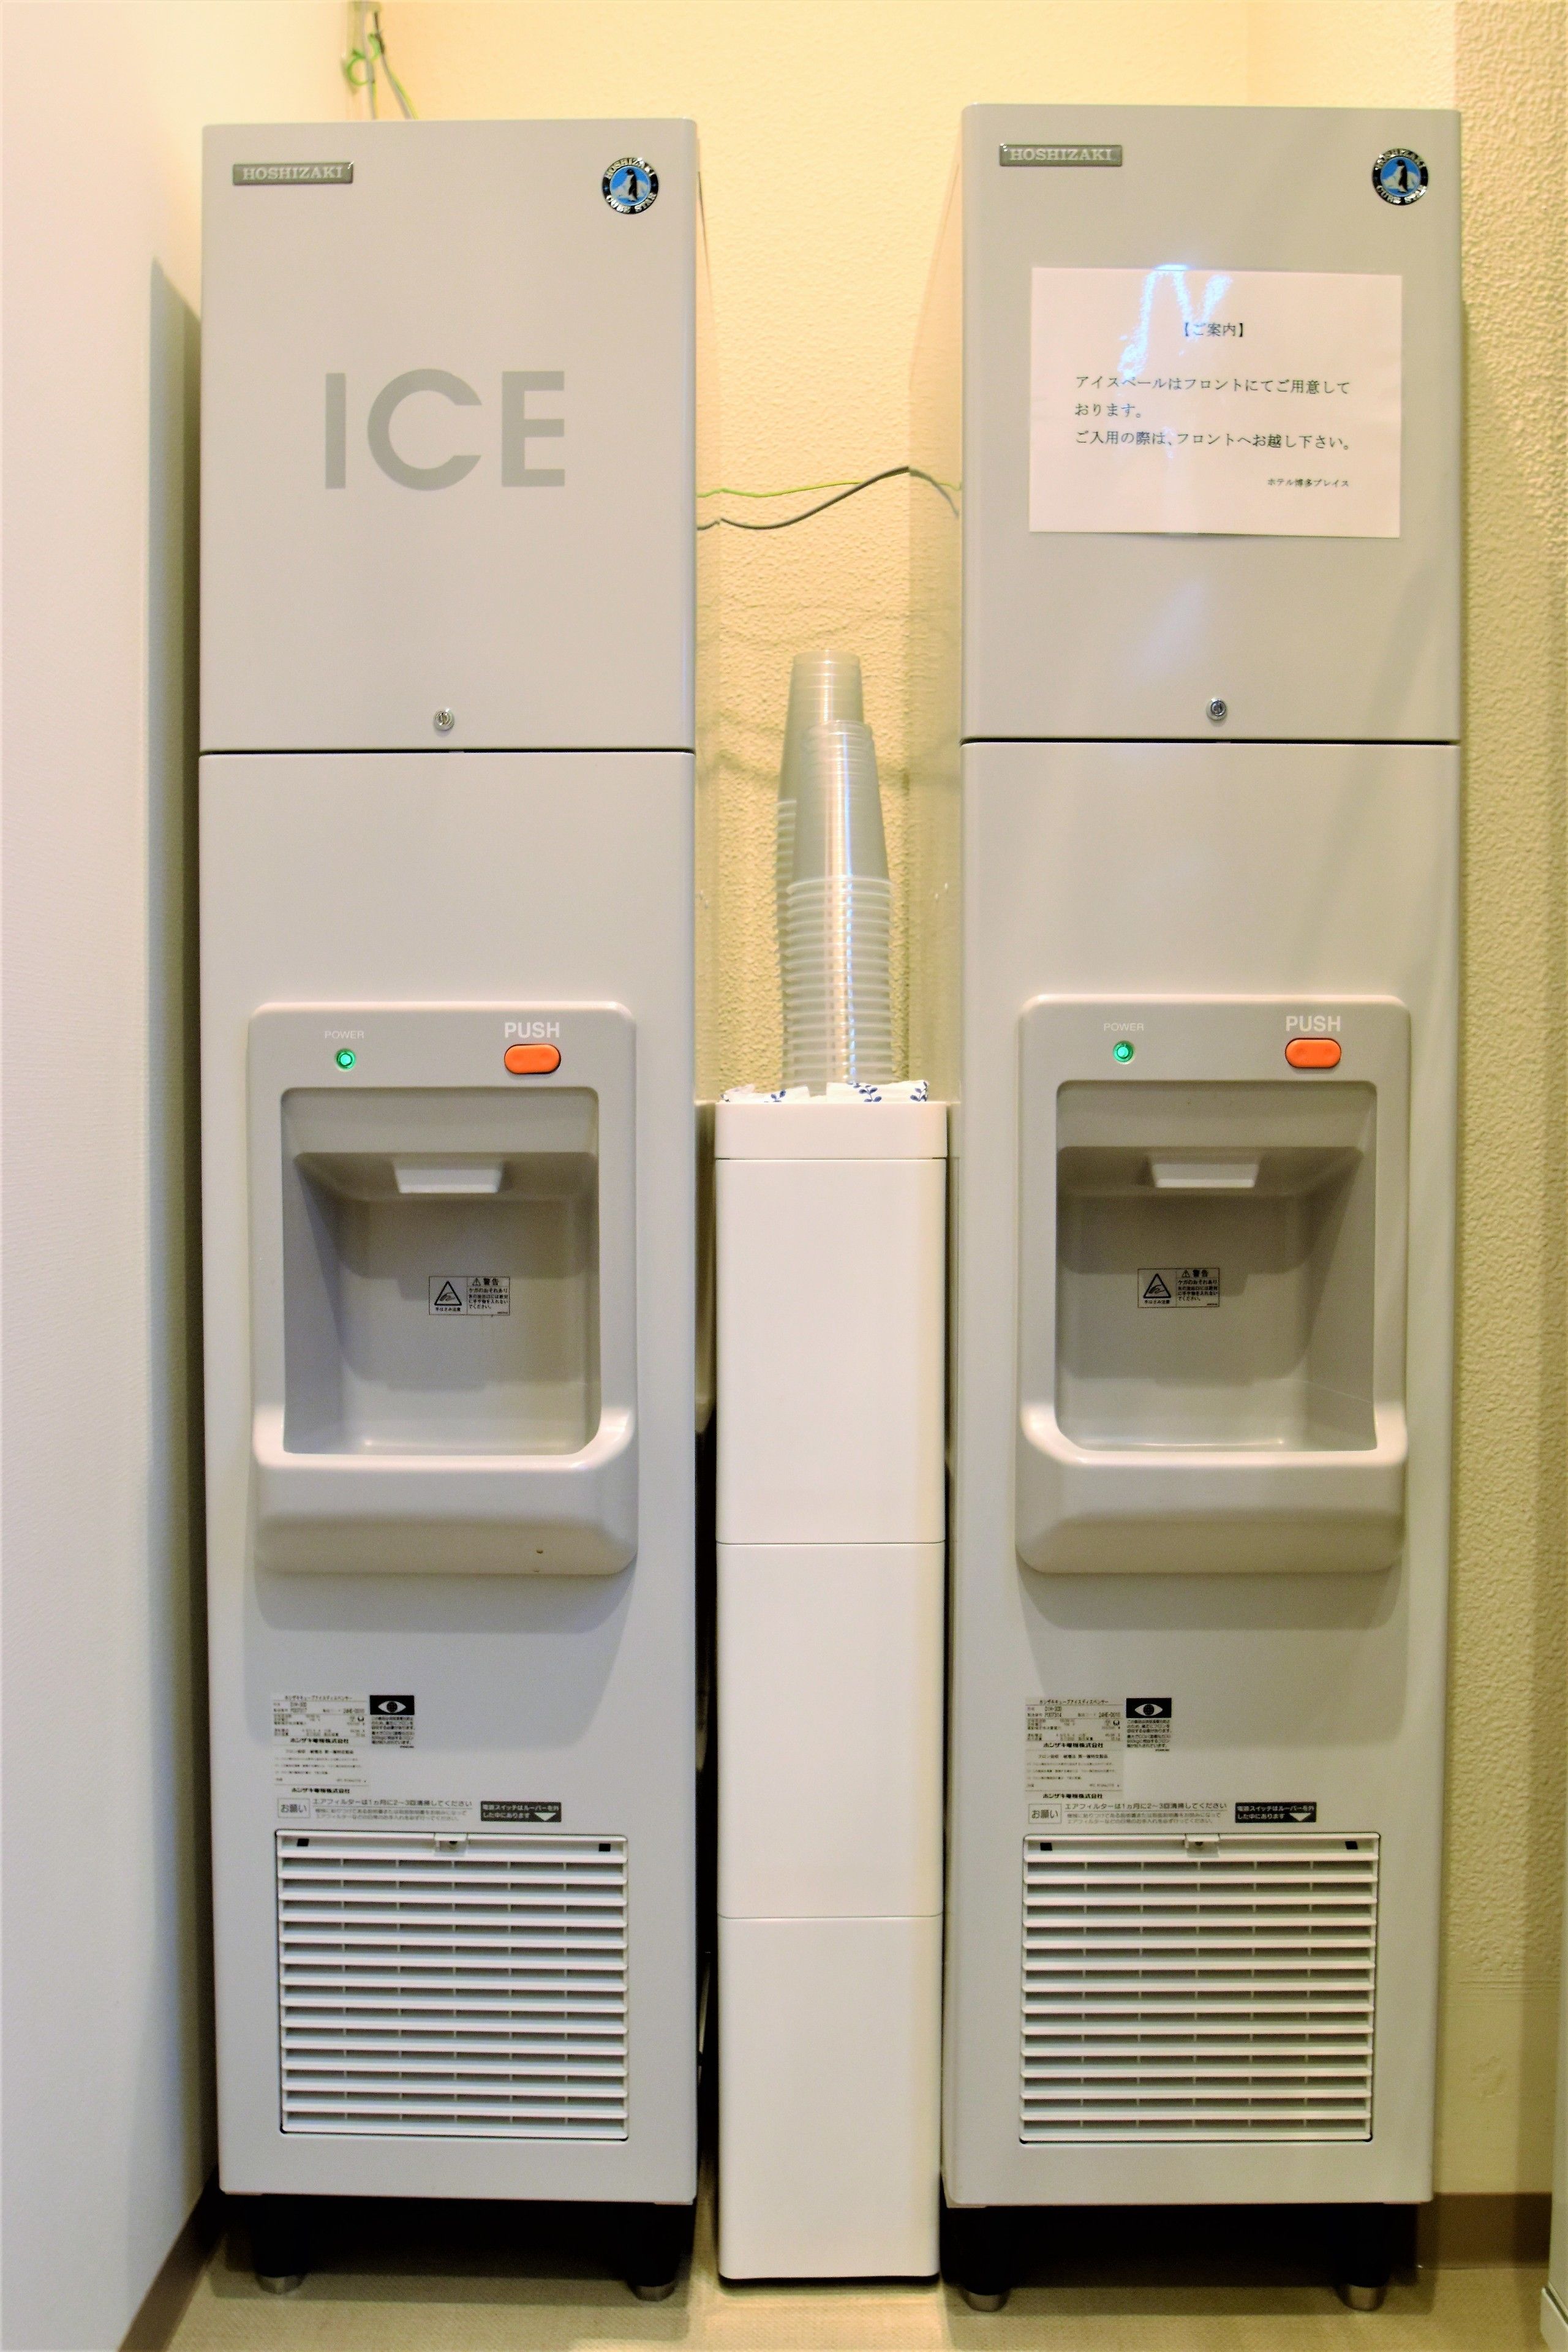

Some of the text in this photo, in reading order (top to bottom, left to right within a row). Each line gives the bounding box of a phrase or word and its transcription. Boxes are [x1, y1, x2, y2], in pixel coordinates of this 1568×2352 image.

[1010, 148, 1113, 161] HOSHIZAKI
[242, 165, 343, 180] HOSHIZAKI
[1184, 322, 1244, 337] 【ご案内】
[1075, 402, 1142, 419] おります。
[325, 368, 565, 491] ICE
[1076, 430, 1350, 450] ご入用の際は、フロントへお越し下さい。
[504, 1022, 560, 1038] PUSH
[1103, 1023, 1144, 1031] POWER
[1286, 1016, 1341, 1032] PUSH
[325, 1031, 364, 1039] POWER
[281, 1804, 307, 1813] お願い
[1031, 1809, 1058, 1819] お願い
